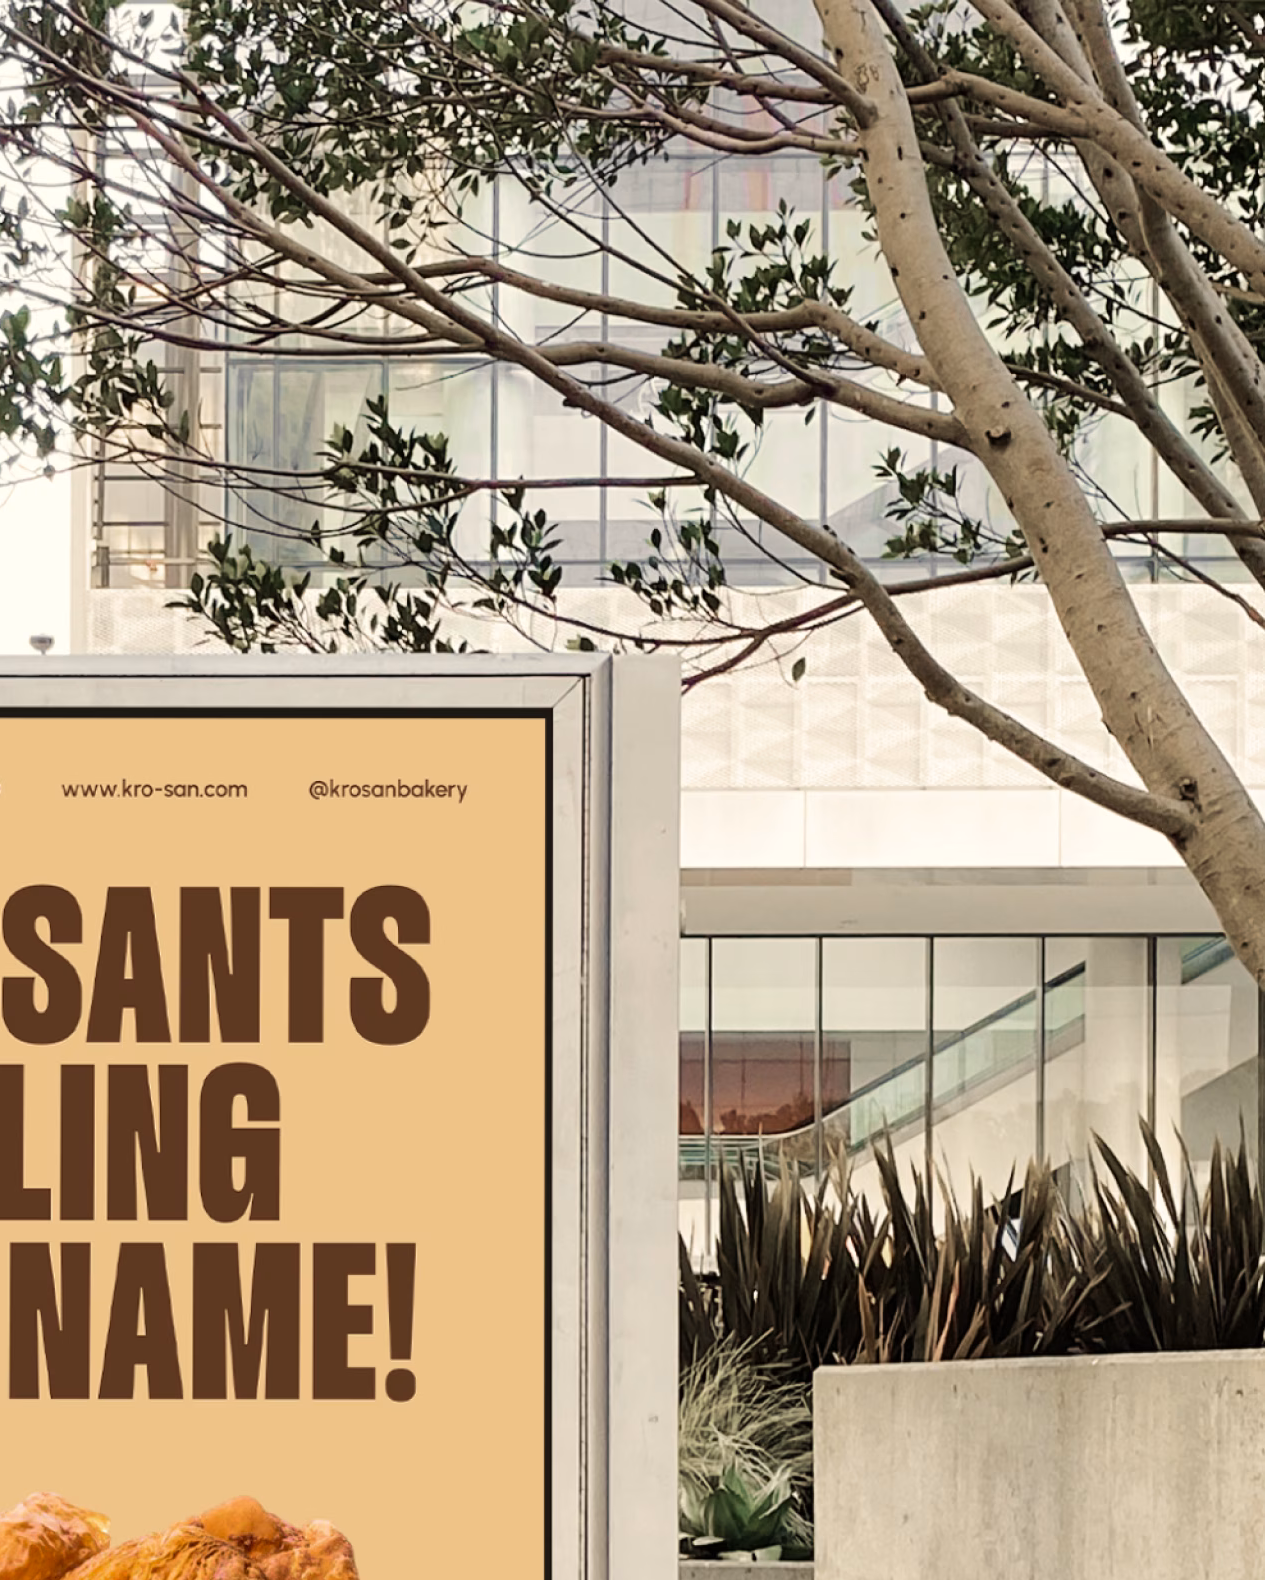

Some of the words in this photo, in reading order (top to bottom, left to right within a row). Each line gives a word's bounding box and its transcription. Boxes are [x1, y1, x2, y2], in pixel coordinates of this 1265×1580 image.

[61, 778, 248, 798] www.kro-san.com
[308, 778, 468, 804] @krosanbakery
[8, 1241, 417, 1403] NAME!
